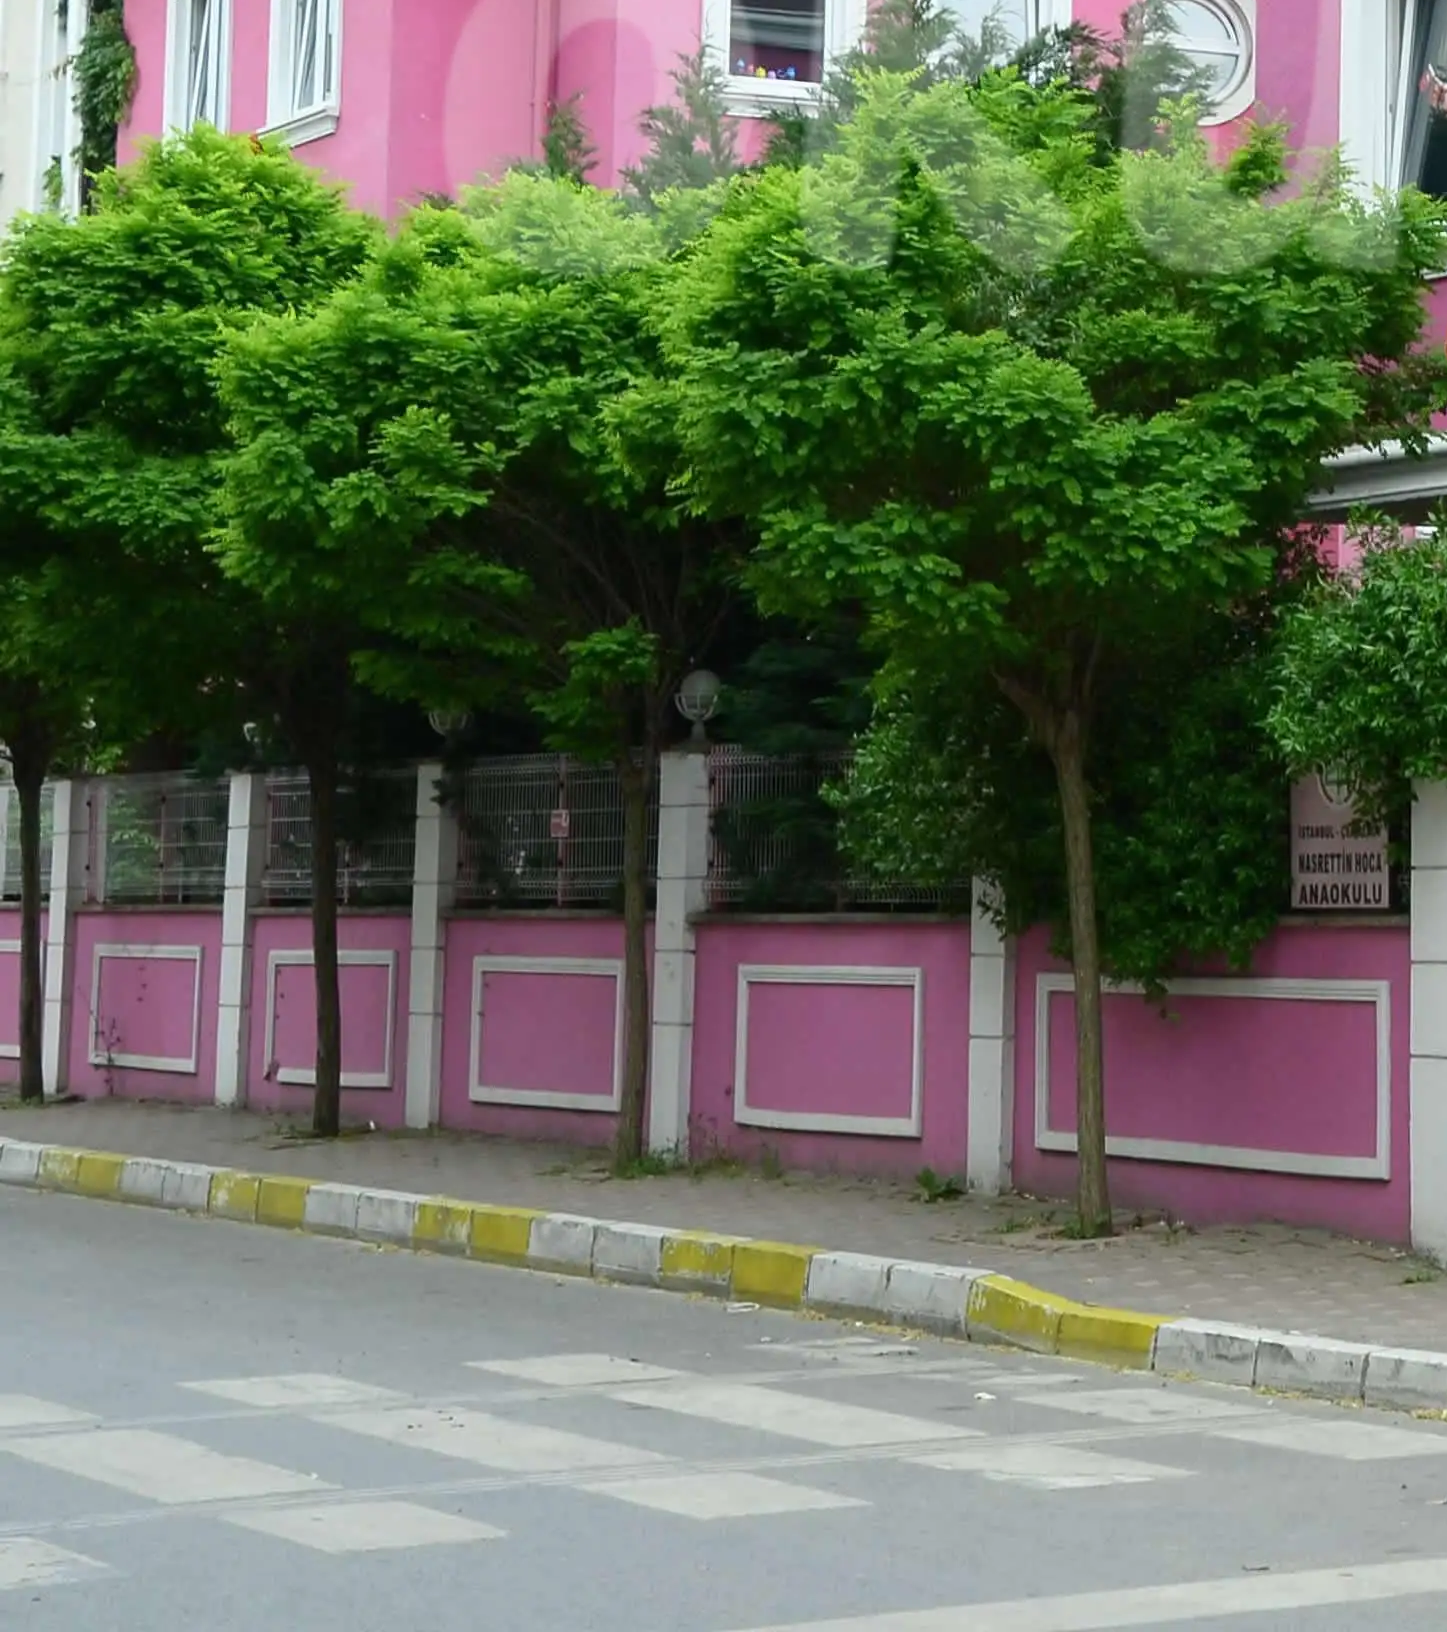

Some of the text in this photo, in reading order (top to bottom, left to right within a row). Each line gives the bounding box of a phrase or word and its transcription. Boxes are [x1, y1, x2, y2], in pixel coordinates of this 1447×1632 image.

[1298, 846, 1382, 873] NASRETTİN HOCA
[1299, 882, 1382, 905] ANAOKULU
